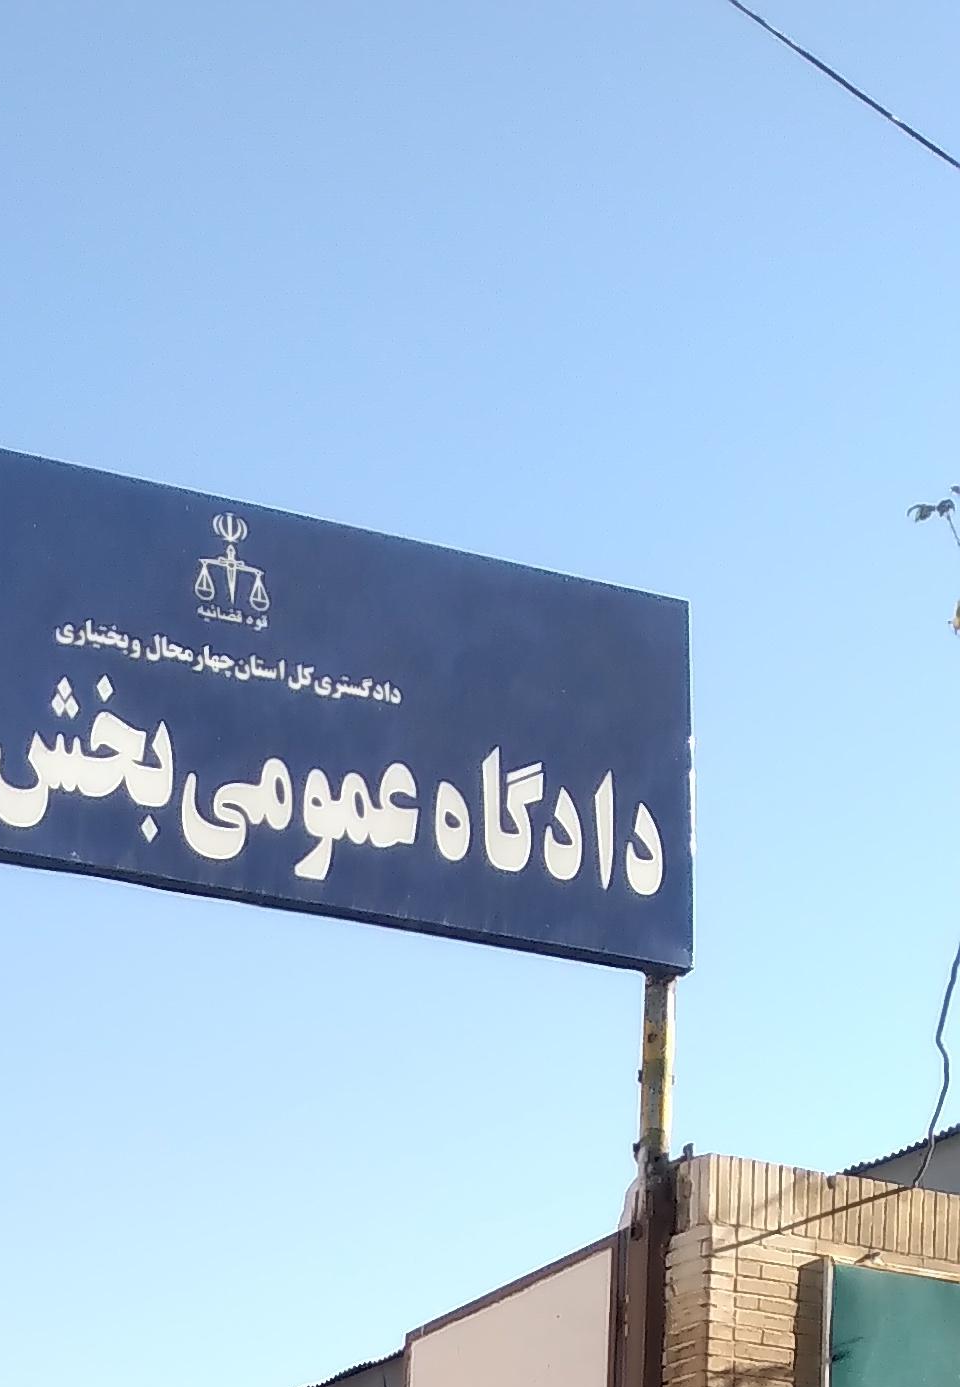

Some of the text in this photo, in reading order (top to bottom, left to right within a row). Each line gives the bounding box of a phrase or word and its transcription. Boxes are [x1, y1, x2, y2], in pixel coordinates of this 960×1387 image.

[246, 613, 268, 631] قوه
[234, 655, 285, 682] استان
[288, 663, 315, 690] کل
[182, 757, 419, 881] عمومی
[436, 745, 665, 896] دادگاه
